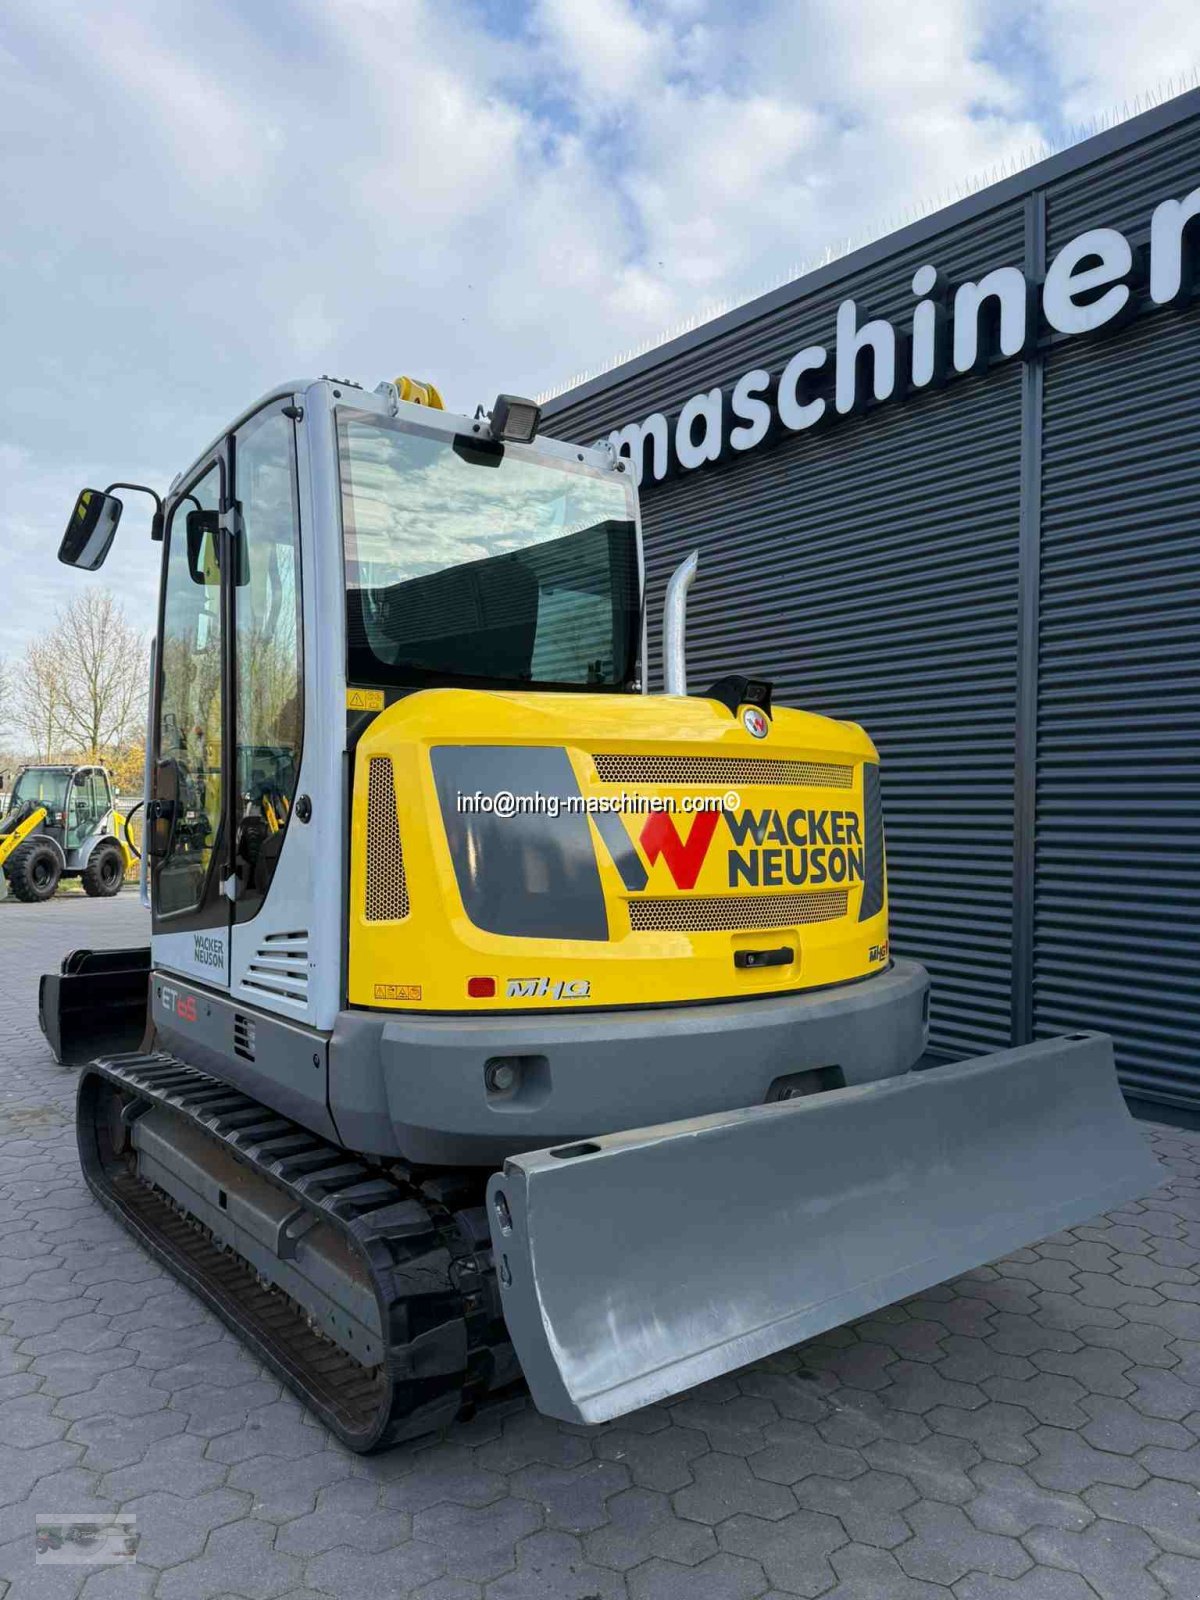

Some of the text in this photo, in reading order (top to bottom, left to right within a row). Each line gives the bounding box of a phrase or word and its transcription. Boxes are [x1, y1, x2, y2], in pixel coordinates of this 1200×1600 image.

[723, 809, 863, 846] WACKER
[728, 847, 865, 888] NEUSON
[194, 934, 224, 954] WACKER
[194, 949, 224, 969] NEUSON
[506, 976, 590, 1001] MHG
